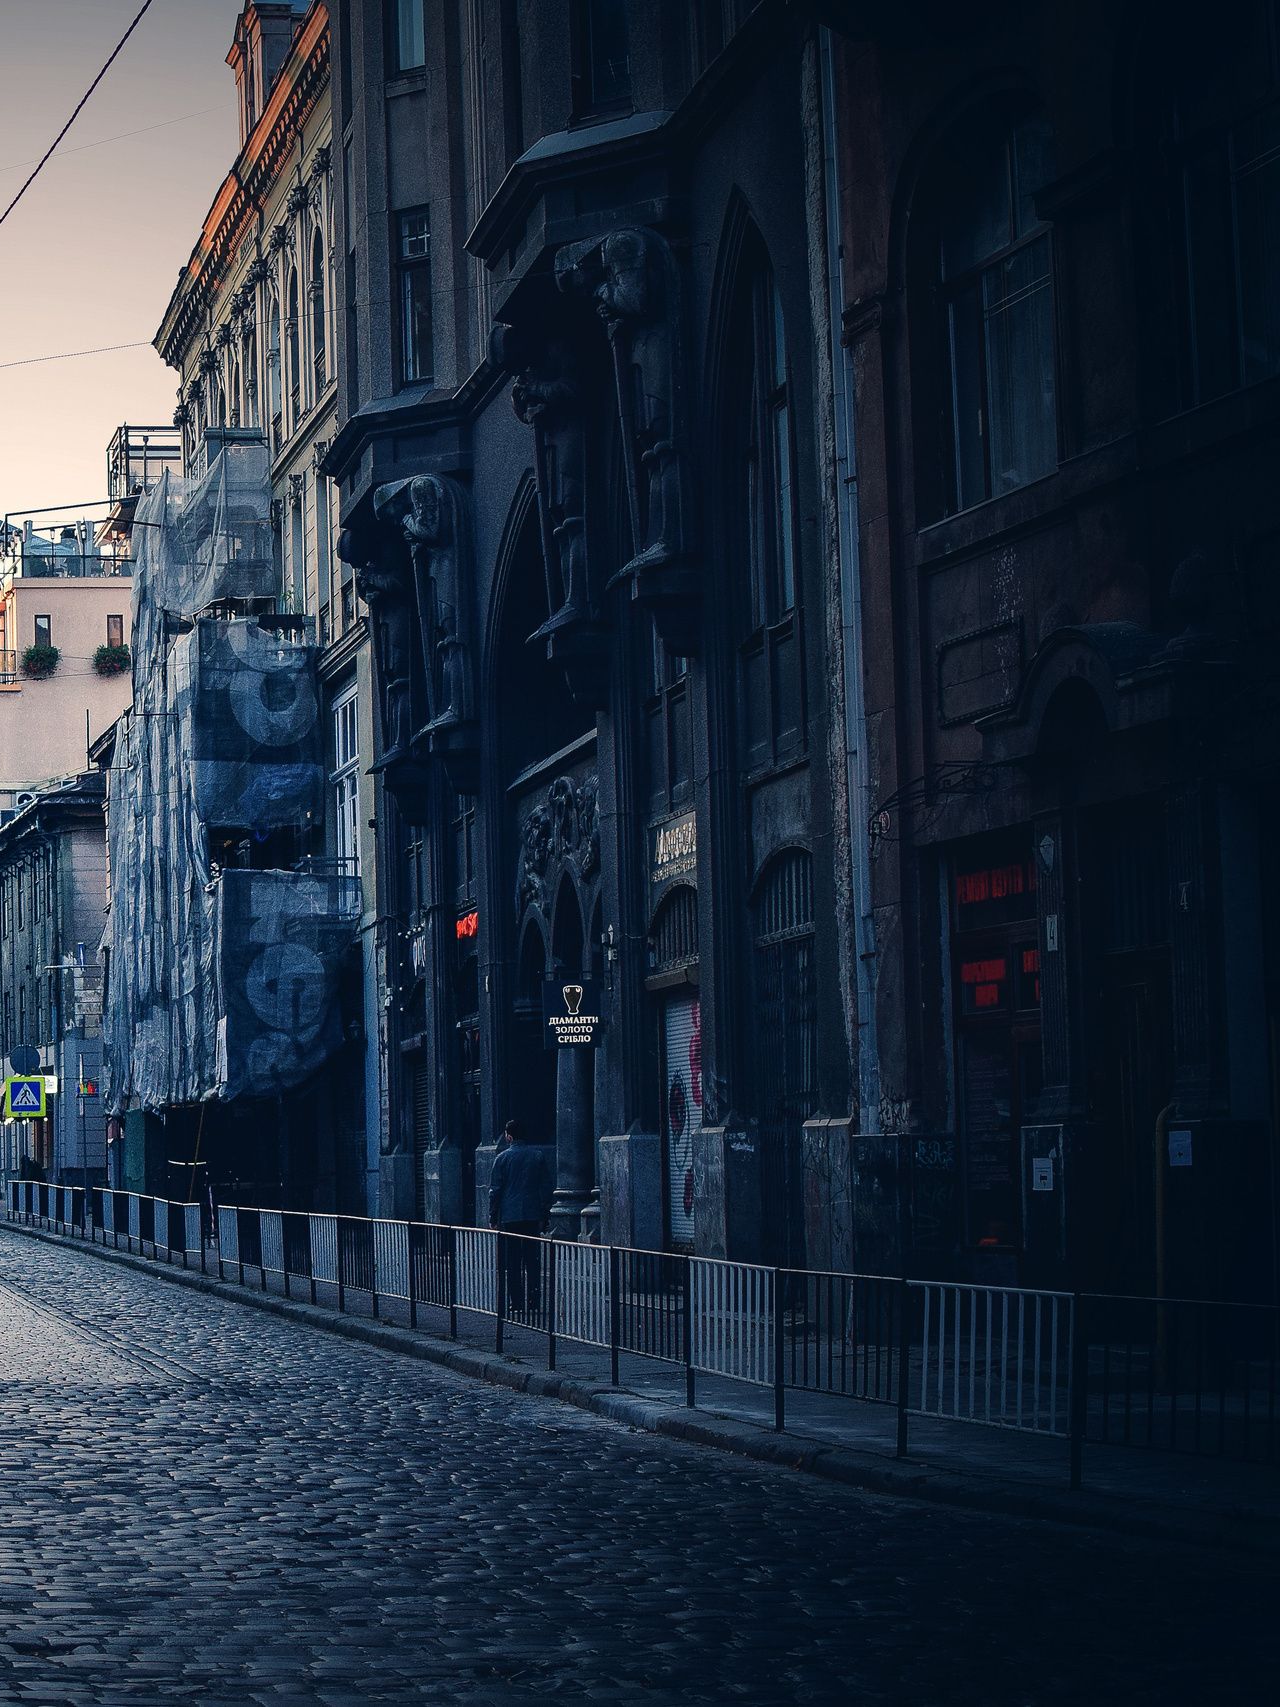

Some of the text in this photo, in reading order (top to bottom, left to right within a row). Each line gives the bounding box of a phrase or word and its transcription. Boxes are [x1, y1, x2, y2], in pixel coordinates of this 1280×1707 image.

[548, 1016, 599, 1026] ДІАМАНТИ
[555, 1025, 594, 1034] ЗОЛОТО
[557, 1034, 592, 1043] СРІБЛО
